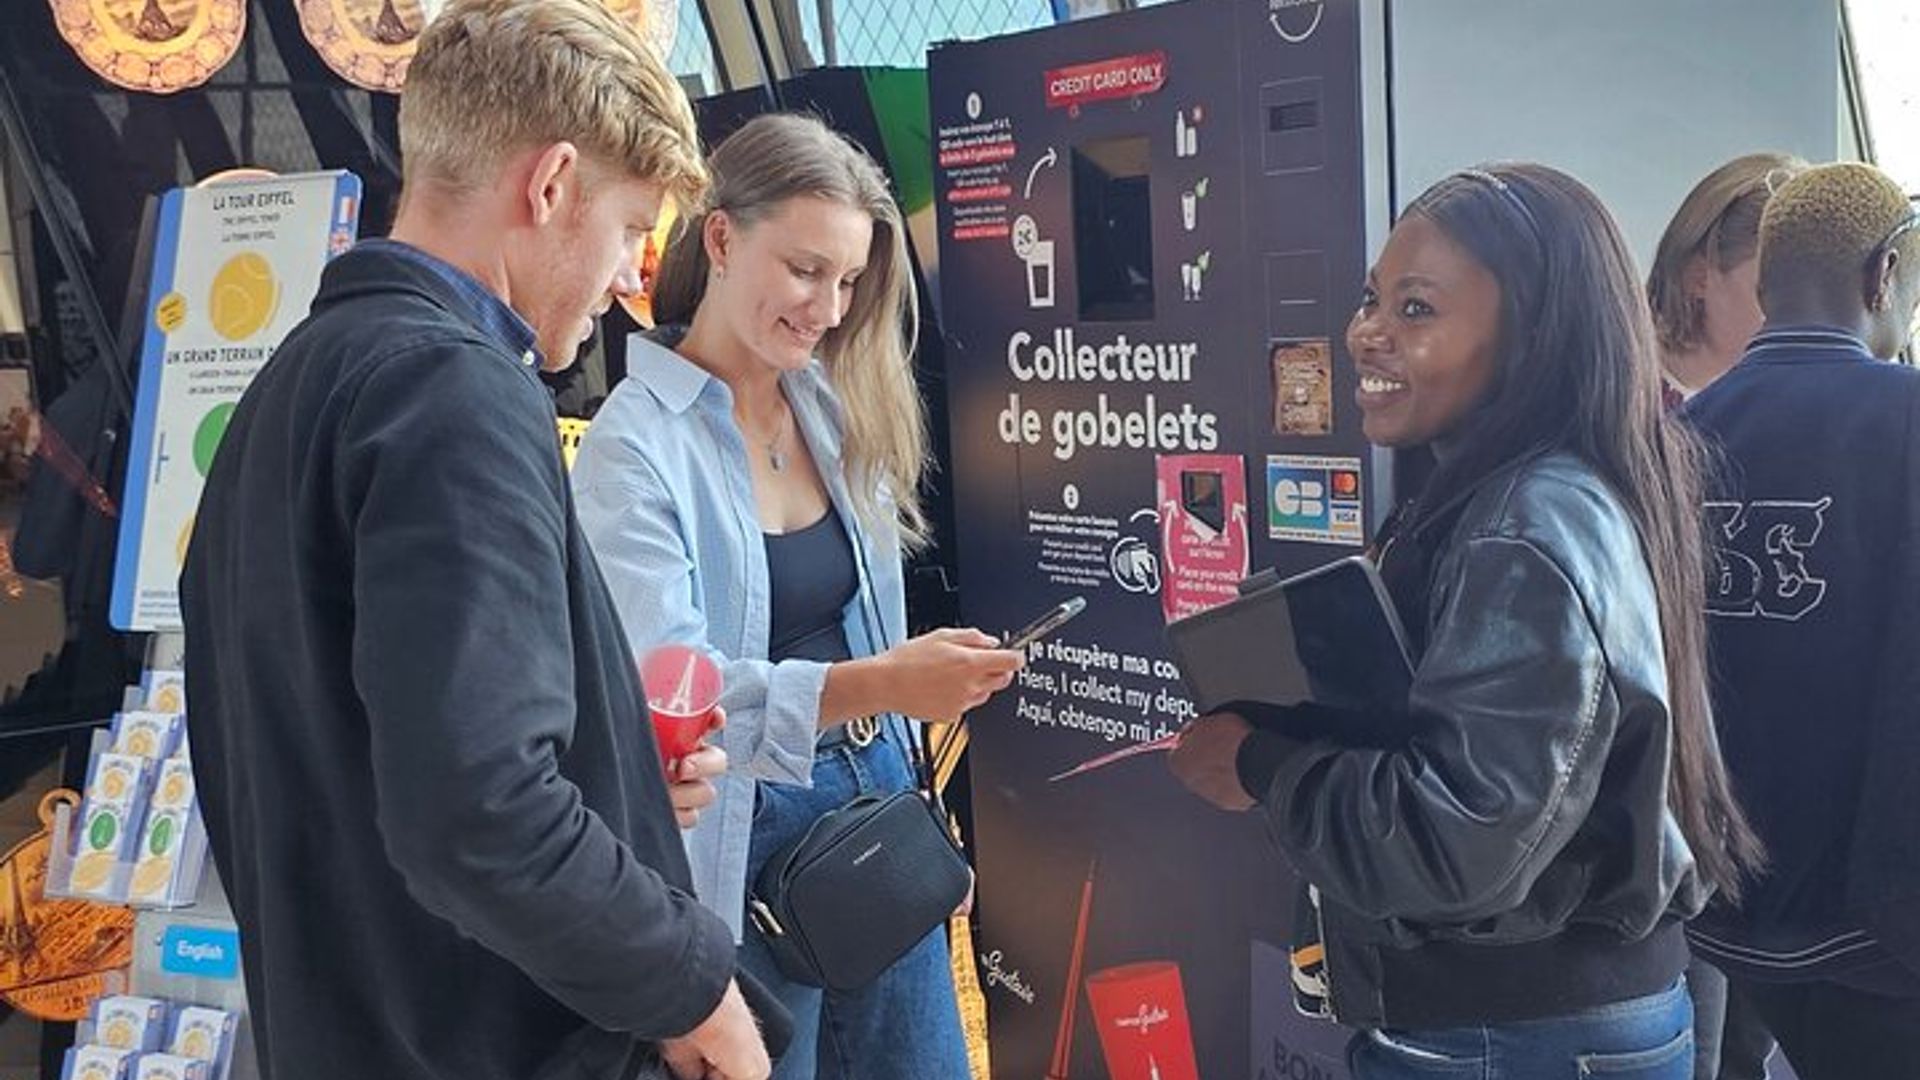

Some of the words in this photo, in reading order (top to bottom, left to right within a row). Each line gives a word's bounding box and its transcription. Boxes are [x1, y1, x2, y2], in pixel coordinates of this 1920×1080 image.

[1051, 75, 1092, 97] CREDIT
[1093, 70, 1127, 90] CARD
[1129, 62, 1163, 83] ONLY
[213, 196, 226, 211] LA
[228, 193, 254, 209] TOUR
[257, 190, 295, 207] EIFFEL
[1008, 327, 1198, 382] Collecteur
[999, 393, 1042, 444] de
[1052, 393, 1218, 461] gobelets
[1029, 640, 1044, 663] je
[1048, 638, 1119, 672] récupère
[1122, 652, 1149, 675] ma
[1018, 665, 1058, 696] Here,
[1071, 674, 1122, 705] collect
[1125, 690, 1152, 716] my
[1016, 696, 1056, 728] Aquí,
[1059, 703, 1127, 742] obtengo
[1130, 720, 1150, 743] mi
[176, 939, 223, 963] English
